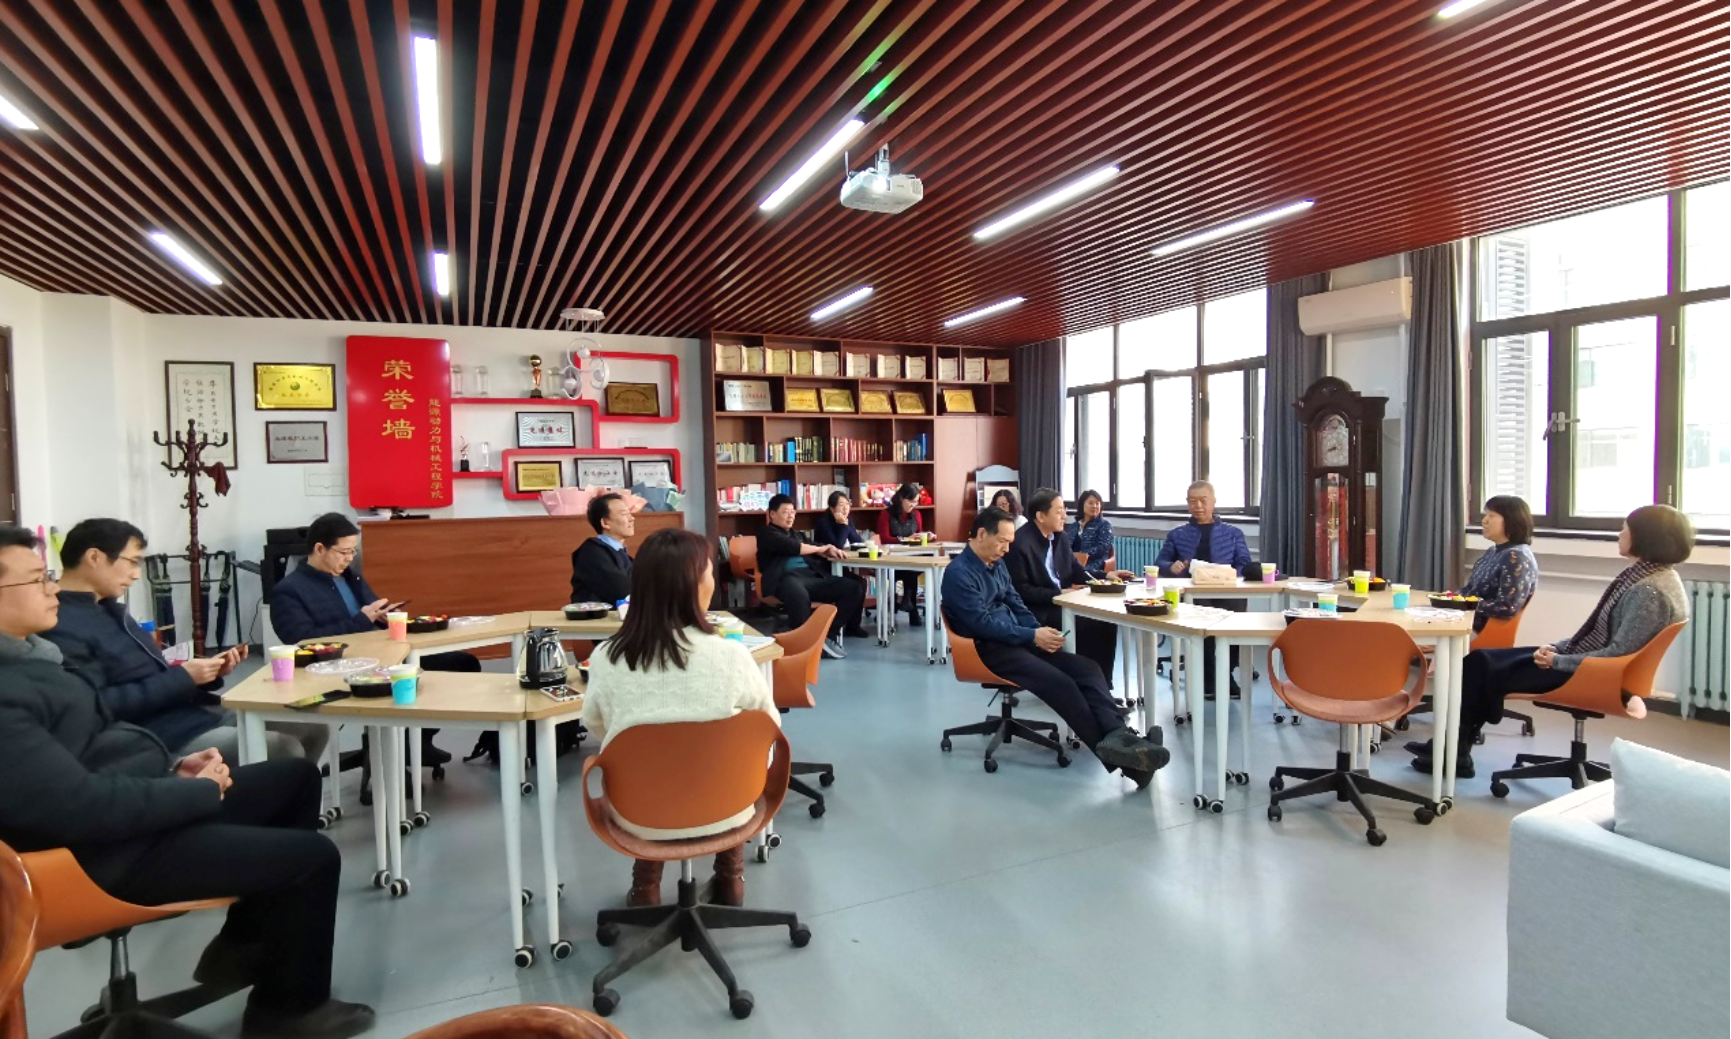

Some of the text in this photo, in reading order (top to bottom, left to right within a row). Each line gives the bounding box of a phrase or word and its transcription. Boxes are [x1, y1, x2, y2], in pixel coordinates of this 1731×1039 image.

[381, 359, 416, 440] 荣誉墙
[428, 398, 443, 500] 能源动力与机械工程学院
